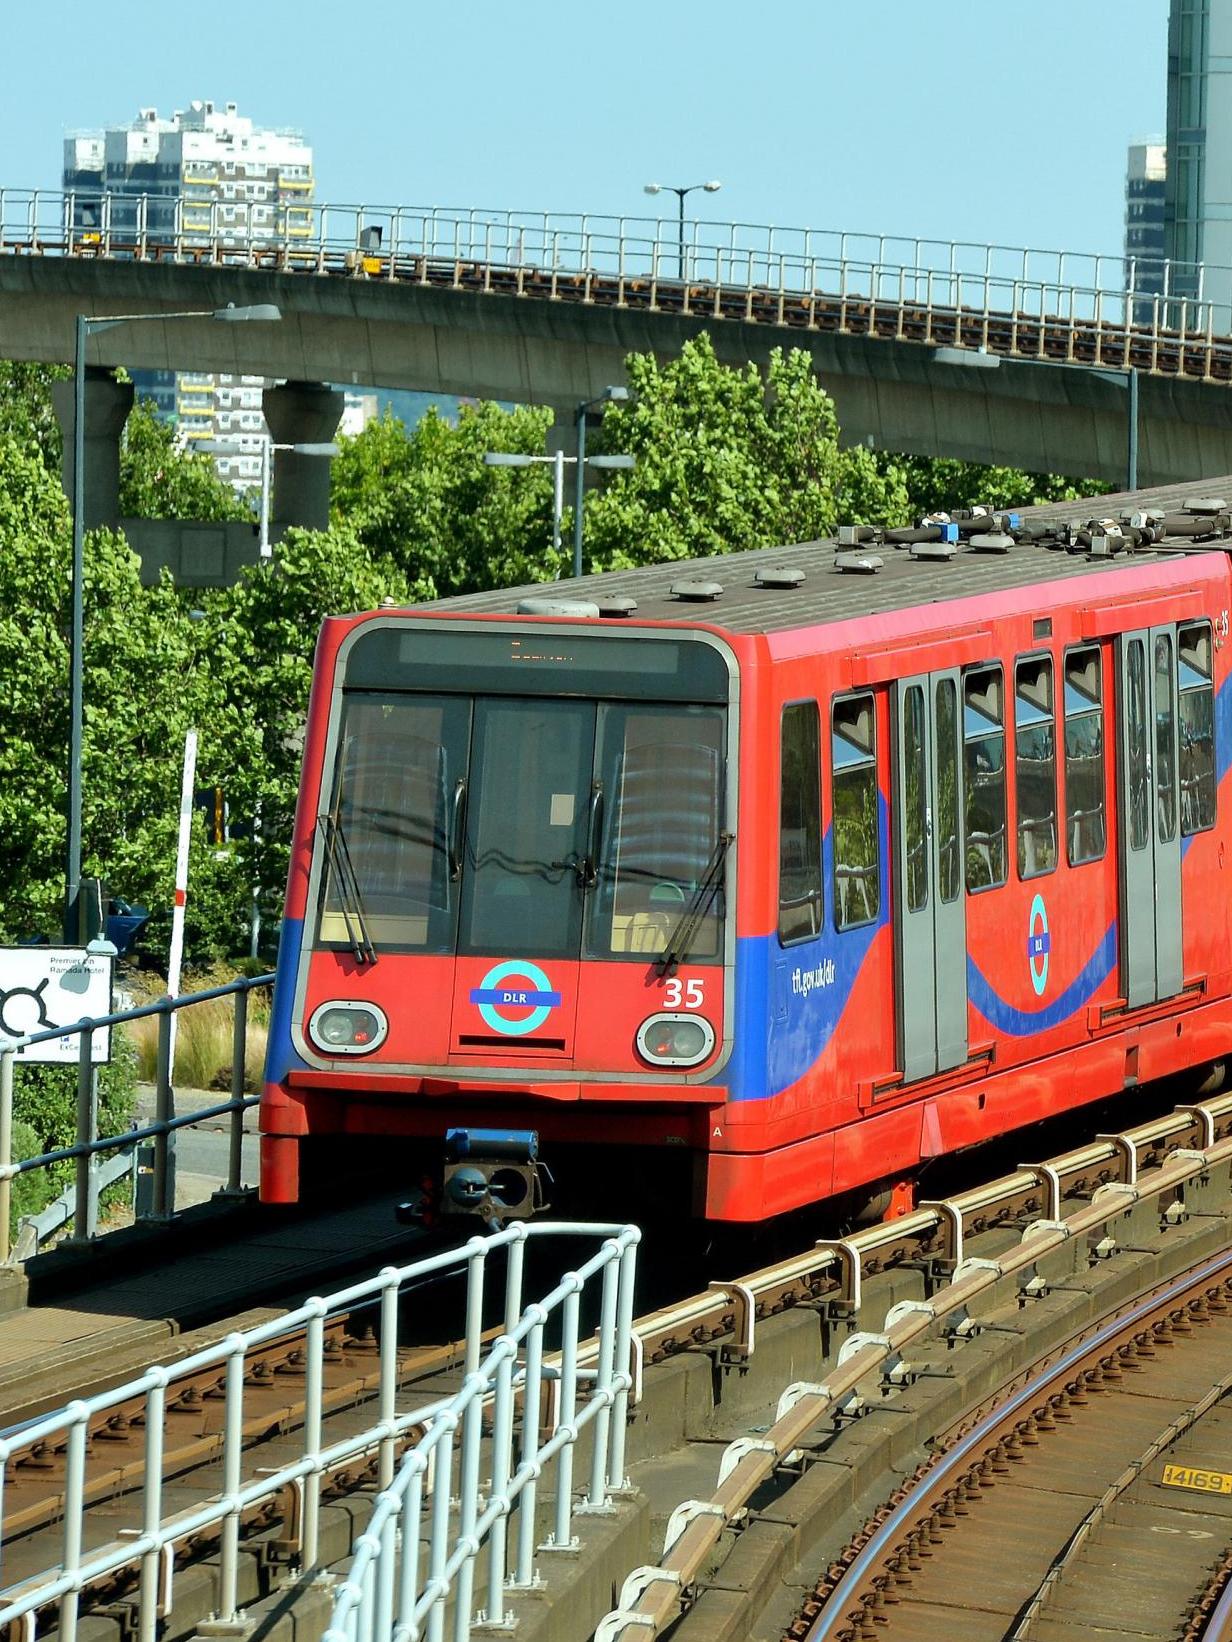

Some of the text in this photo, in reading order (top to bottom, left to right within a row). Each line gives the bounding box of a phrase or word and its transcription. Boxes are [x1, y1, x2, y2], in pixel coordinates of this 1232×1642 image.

[1221, 610, 1229, 637] 35
[792, 958, 835, 998] tfl.gov.uk/dlr
[502, 992, 527, 1004] DLR
[662, 979, 705, 1009] 35
[712, 1126, 722, 1137] A
[1166, 1467, 1223, 1490] 14169
